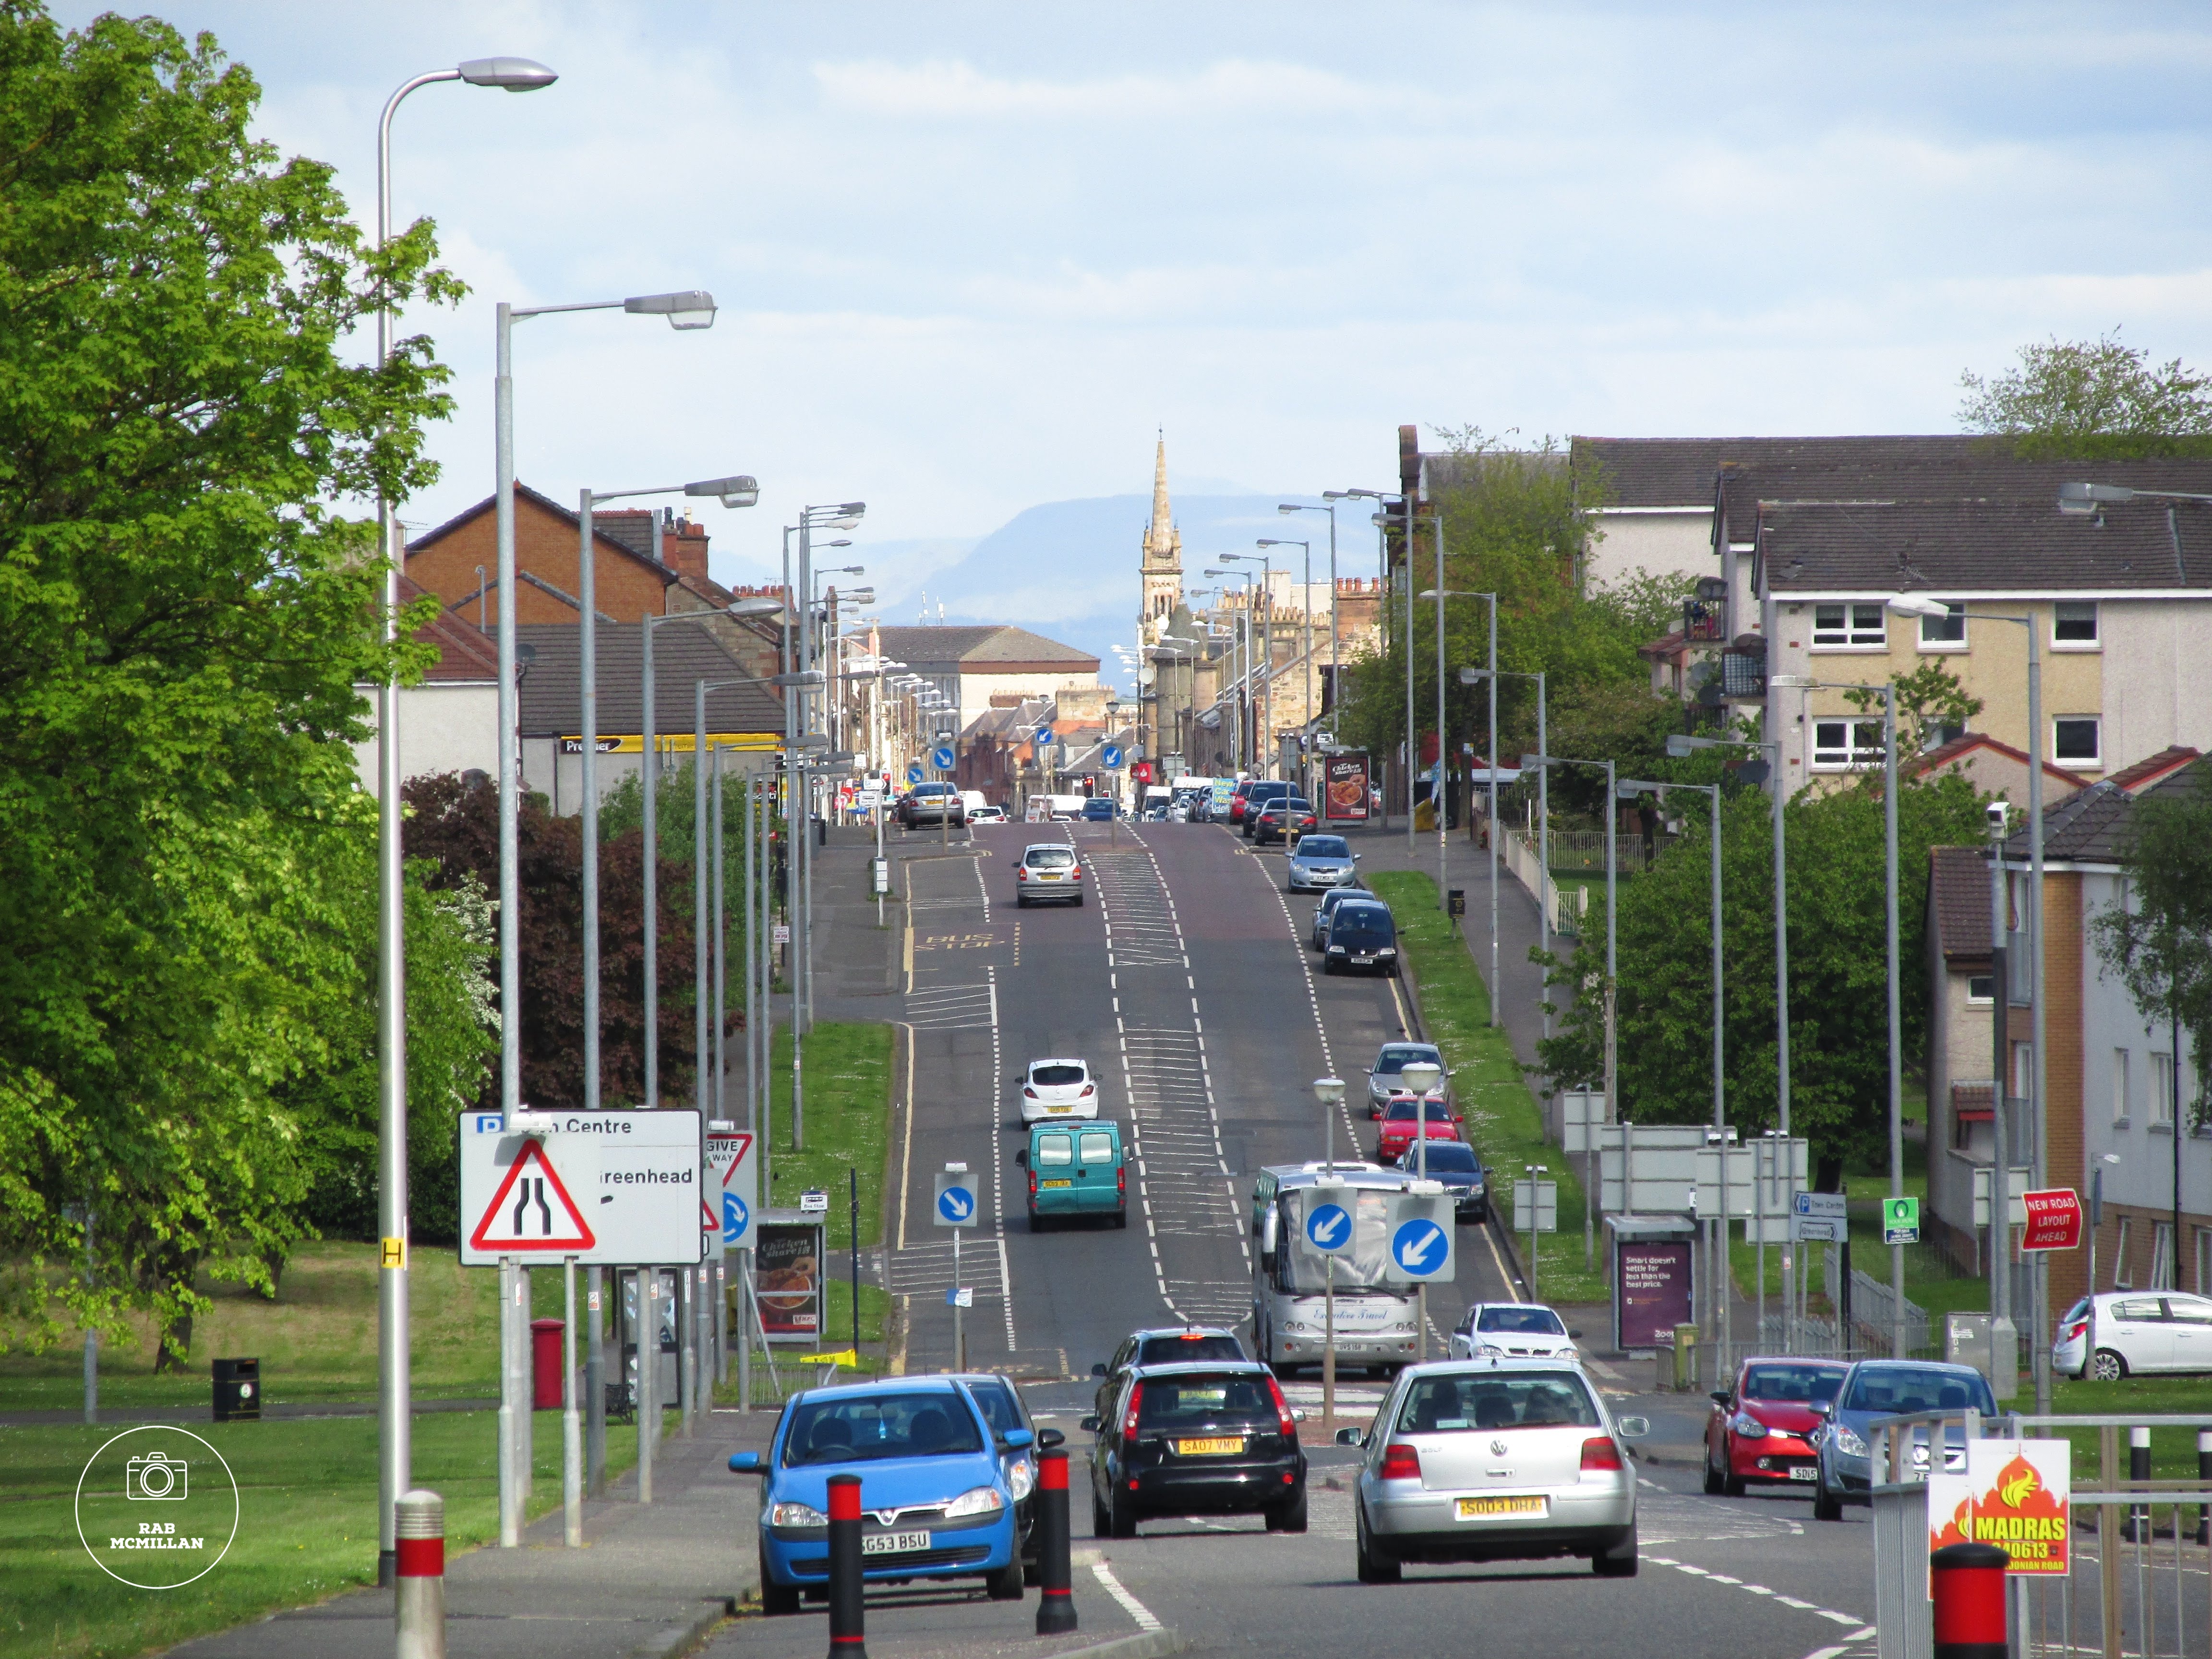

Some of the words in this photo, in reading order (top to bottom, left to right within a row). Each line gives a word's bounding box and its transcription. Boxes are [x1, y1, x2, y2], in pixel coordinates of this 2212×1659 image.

[566, 741, 610, 751] Preier
[926, 934, 994, 943] BUS
[914, 940, 1005, 951] STOP
[566, 1118, 632, 1133] Centre
[707, 1141, 738, 1152] GIVE
[600, 1168, 692, 1183] reenhead
[2027, 1200, 2048, 1211] NEW
[2050, 1198, 2075, 1209] ROAD
[2038, 1214, 2071, 1227] LAYOUT
[2034, 1231, 2067, 1242] AHEAD
[383, 1241, 402, 1264] H
[1358, 1308, 1389, 1319] Travel
[1184, 1441, 1213, 1451] SA07
[1217, 1440, 1237, 1449] VMY
[1975, 1517, 2066, 1540] MADRAS
[899, 1533, 926, 1549] BSU
[2041, 1561, 2064, 1570] ROAD
